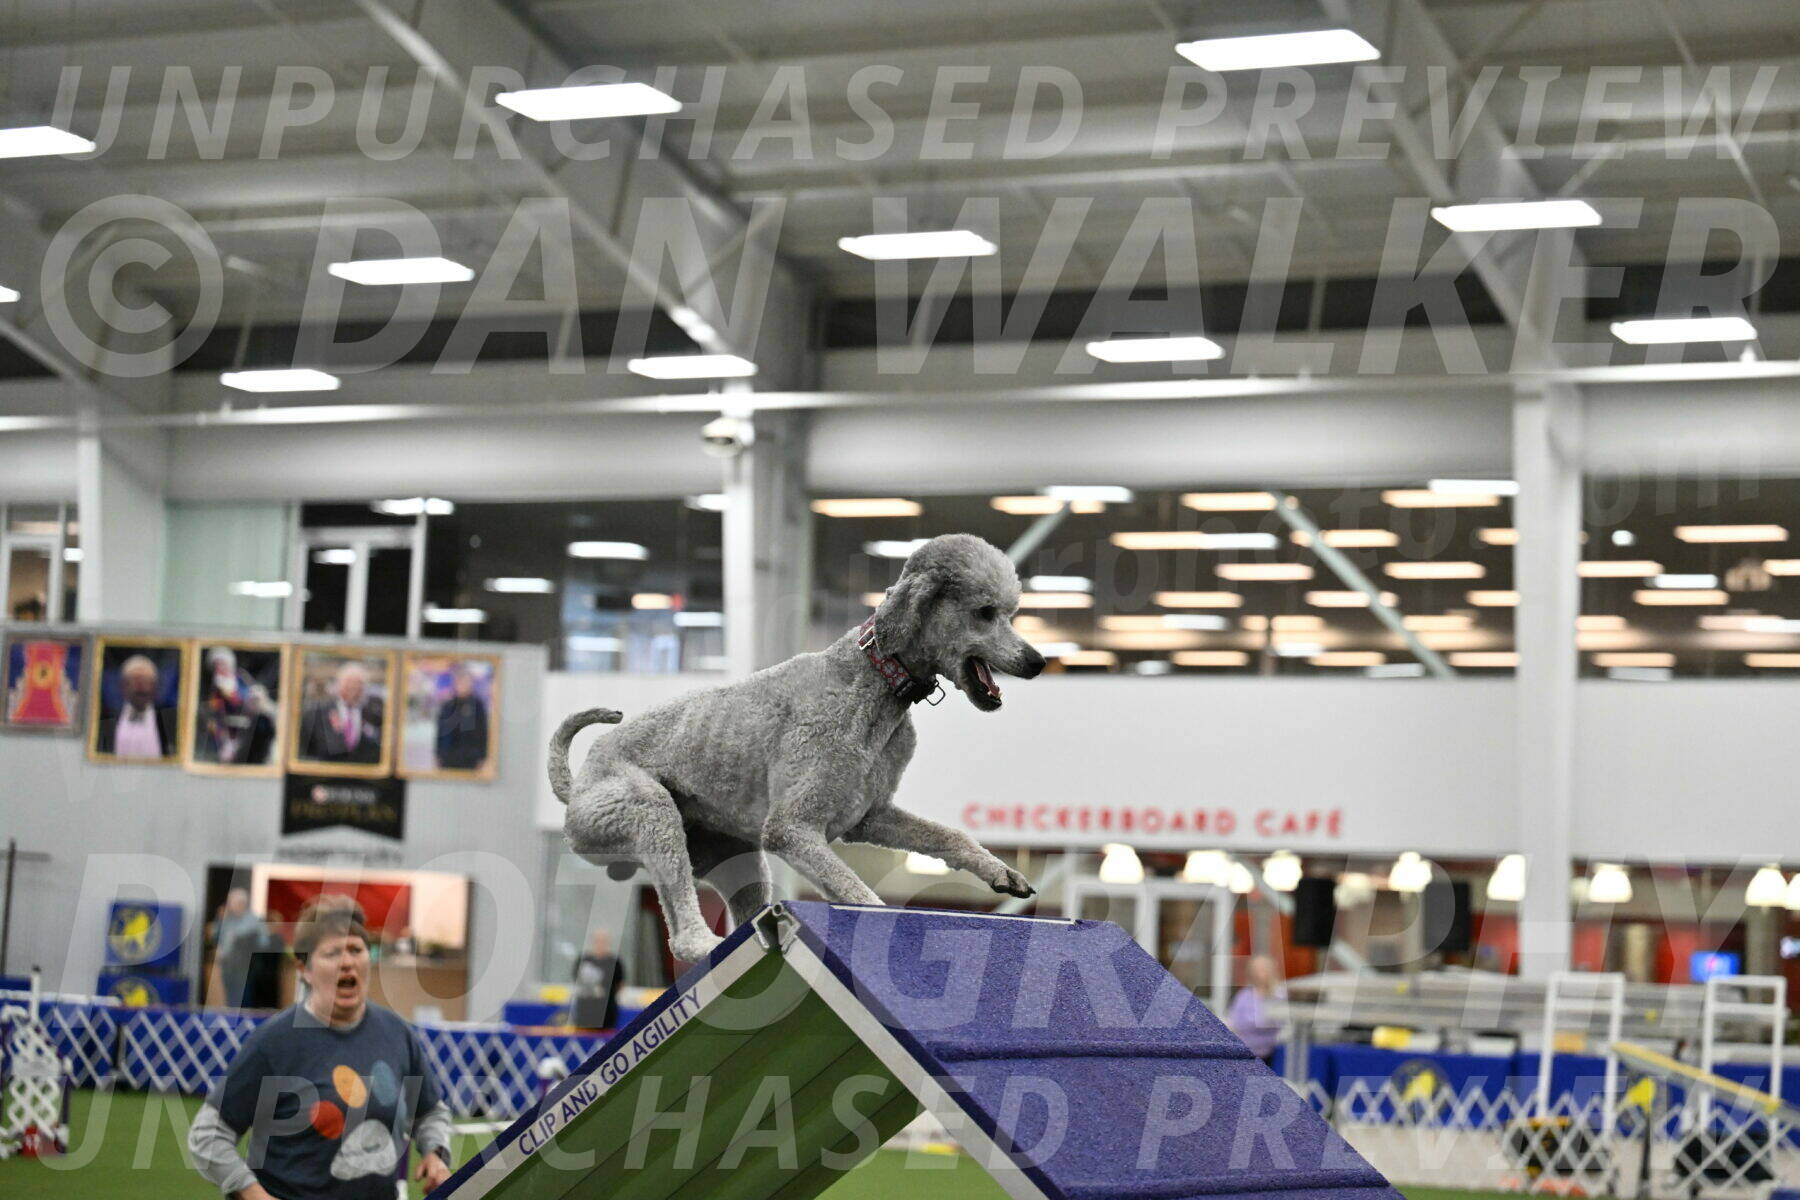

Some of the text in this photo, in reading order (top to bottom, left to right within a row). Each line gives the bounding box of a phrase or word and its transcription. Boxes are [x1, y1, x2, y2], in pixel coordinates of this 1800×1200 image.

[962, 802, 1343, 838] CHECKERBOARD CAFÉ
[519, 987, 702, 1156] CLIP AND GO AGILITY
